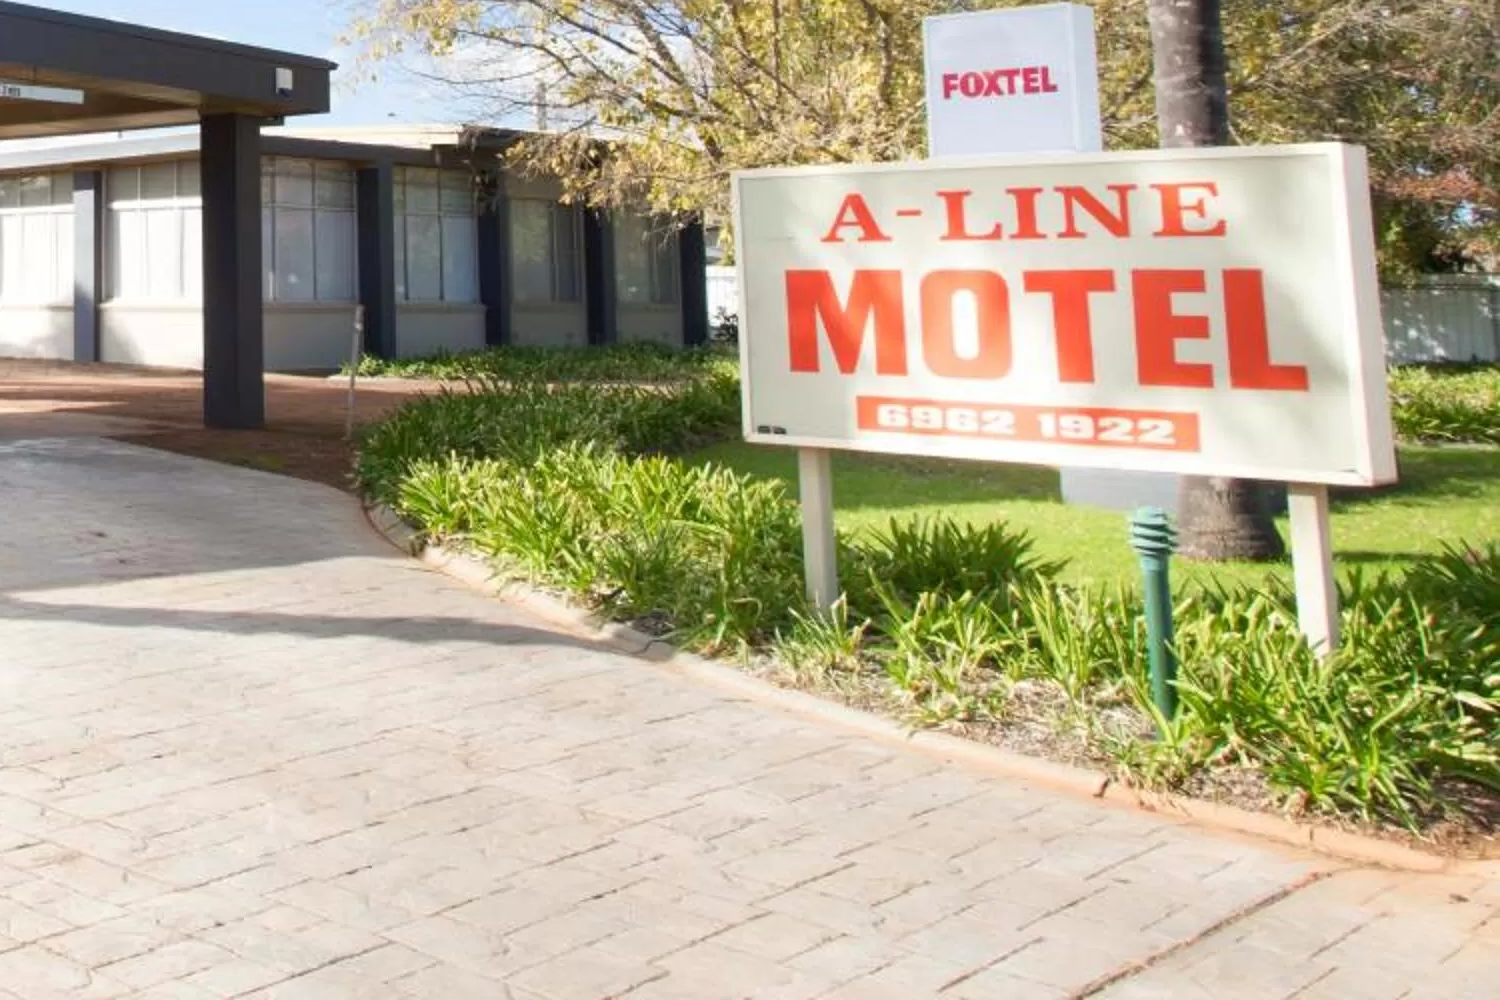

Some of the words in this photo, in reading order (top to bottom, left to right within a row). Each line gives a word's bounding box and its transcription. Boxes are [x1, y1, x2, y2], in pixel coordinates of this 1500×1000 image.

[942, 66, 1057, 98] FOXTEL
[821, 182, 1226, 243] A-LINE
[785, 268, 1310, 391] MOTEL
[876, 403, 1015, 435] 6962
[1036, 412, 1176, 445] 1922
